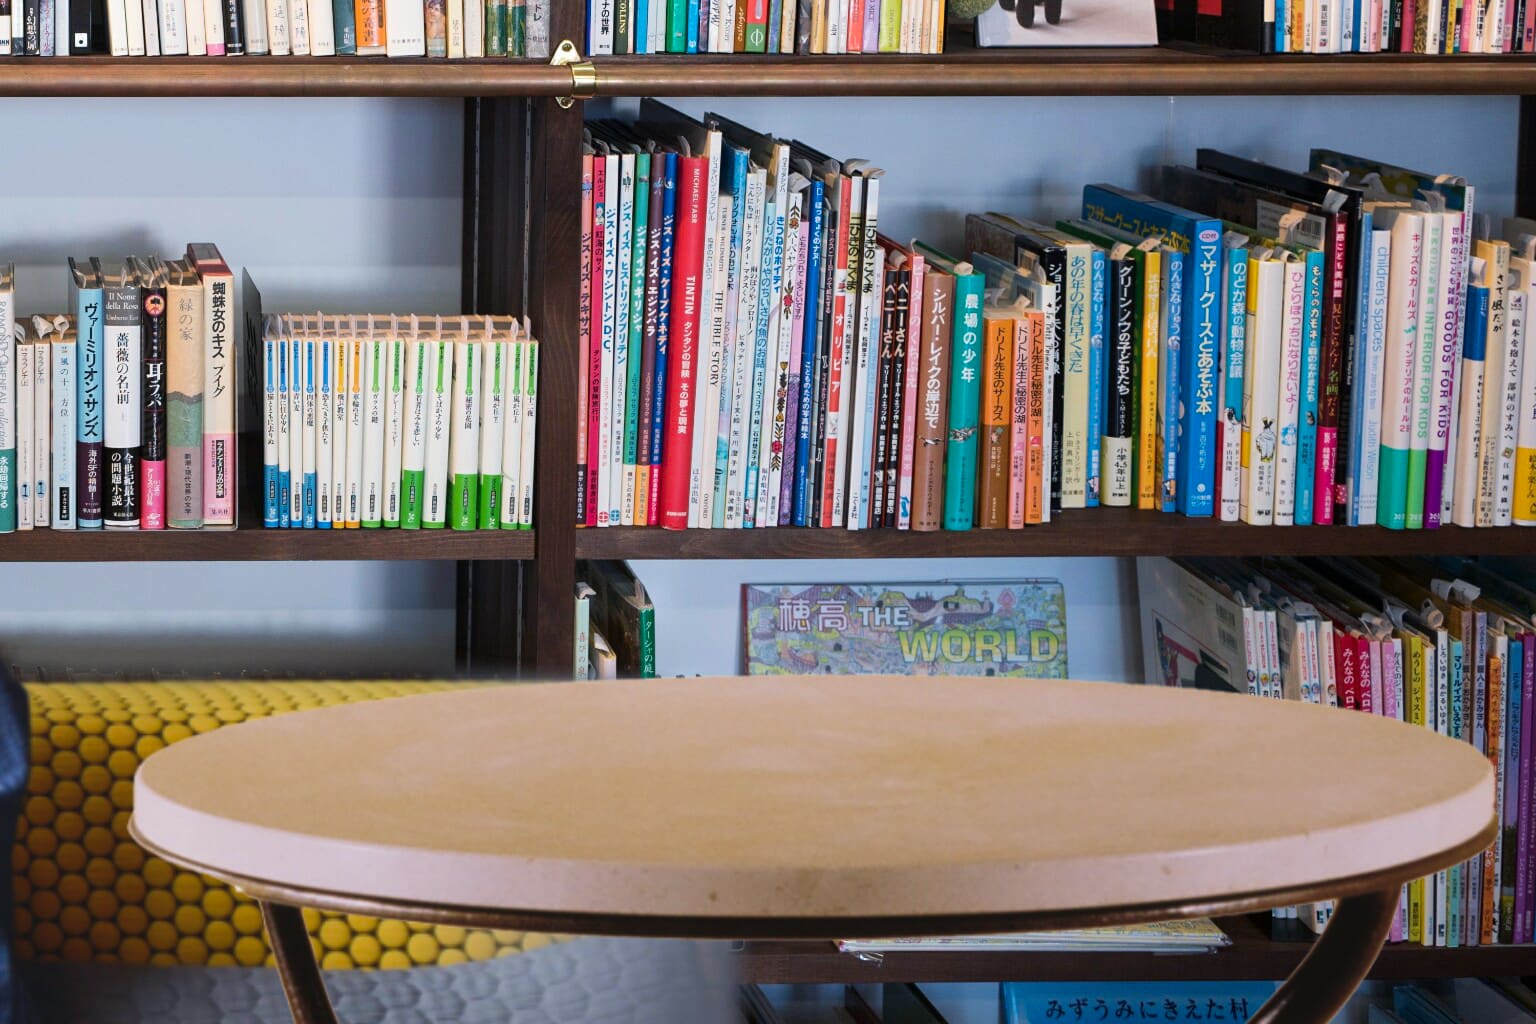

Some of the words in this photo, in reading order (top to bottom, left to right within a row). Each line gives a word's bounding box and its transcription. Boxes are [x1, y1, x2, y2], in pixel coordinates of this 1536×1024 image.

[774, 216, 785, 293] きつねのホイティ
[1375, 246, 1389, 306] children's
[106, 302, 120, 310] della
[109, 292, 115, 300] Il
[116, 292, 136, 301] Nome
[211, 282, 226, 360] 蜘蛛女のキス
[685, 276, 695, 314] TINTIN
[714, 292, 723, 312] THE
[882, 280, 896, 360] ペニーさん
[893, 279, 909, 359] ペニーさん
[1068, 256, 1086, 374] あの年の春は早くきた
[1229, 262, 1247, 380] のどか森の動物会議
[680, 321, 693, 378] タンタンの冒険
[712, 314, 723, 346] BIBLE
[831, 314, 844, 394] オリビア
[961, 294, 979, 383] 農場の少年
[1116, 265, 1133, 396] グリーン・ノウの子どもたち
[1195, 246, 1218, 415] マザーグースとあそぶ本
[1372, 308, 1384, 352] spaces
[1421, 312, 1434, 374] INTERIOR
[1441, 311, 1454, 363] GOODS
[83, 303, 98, 438] ヴァーミリオン・サンズ
[117, 332, 129, 405] 薔薇の名前
[147, 362, 163, 408] 耳ラッパ
[709, 350, 720, 386] STORY
[924, 290, 947, 429] シルバー・レイクの岸辺で
[993, 328, 1005, 422] ドリトル先生のサーカス
[1439, 370, 1451, 399] FOR
[1418, 378, 1432, 404] FOR
[1417, 407, 1430, 439] KIDS
[1437, 405, 1449, 439] KIDS
[858, 606, 910, 628] THE
[897, 630, 1059, 663] WORLD
[1046, 998, 1250, 1021] みずうみにきえた村
